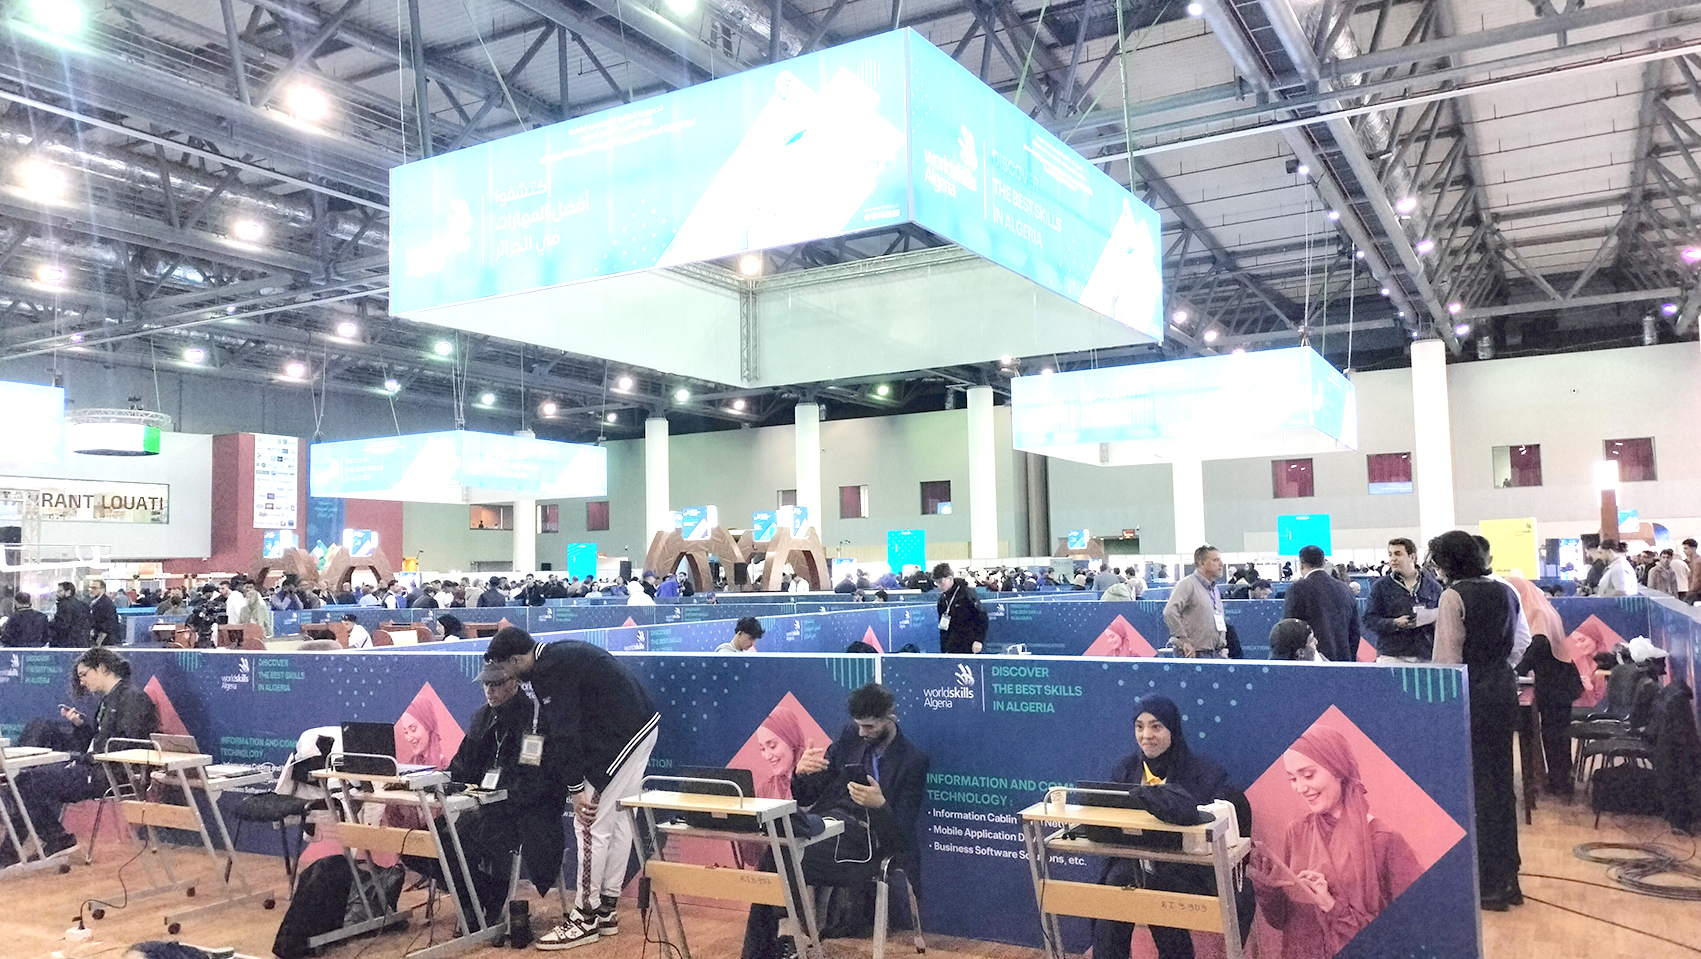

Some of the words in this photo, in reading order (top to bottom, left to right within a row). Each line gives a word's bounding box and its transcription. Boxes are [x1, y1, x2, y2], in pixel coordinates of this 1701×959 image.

[992, 148, 1040, 193] DISCOVER
[552, 189, 590, 223] أفضل
[992, 176, 1012, 204] THE
[1013, 184, 1034, 216] BEST
[1034, 203, 1062, 233] SKILLS
[495, 205, 549, 231] المهارات
[993, 205, 1004, 227] IN
[1005, 213, 1043, 248] ALGERIA
[494, 234, 533, 261] الجزائر
[536, 229, 561, 257] في
[102, 494, 164, 511] LOUATI
[258, 658, 289, 667] DISCOVER
[221, 673, 250, 683] worldskills
[258, 671, 270, 679] THE
[285, 671, 306, 680] SKILLS
[991, 665, 1050, 678] DISCOVER
[264, 683, 291, 692] ALGERIA
[923, 686, 975, 699] worldskills
[992, 683, 1014, 694] THE
[1015, 684, 1042, 695] BEST
[1043, 684, 1083, 697] SKILLS
[923, 697, 953, 711] Algeria
[993, 701, 1005, 711] IN
[1006, 701, 1056, 714] ALGERIA
[221, 736, 265, 746] INFORMATION
[265, 738, 279, 748] AND
[926, 773, 1008, 789] INFORMATION
[1010, 779, 1037, 791] AND
[926, 789, 1008, 806] TECHNOLOGY
[932, 808, 986, 821] Information
[987, 812, 1018, 825] Cablin
[933, 825, 963, 836] Mobile
[964, 827, 1017, 842] Application
[934, 841, 974, 854] Business
[974, 845, 1018, 859] Software
[1068, 856, 1087, 866] etc.
